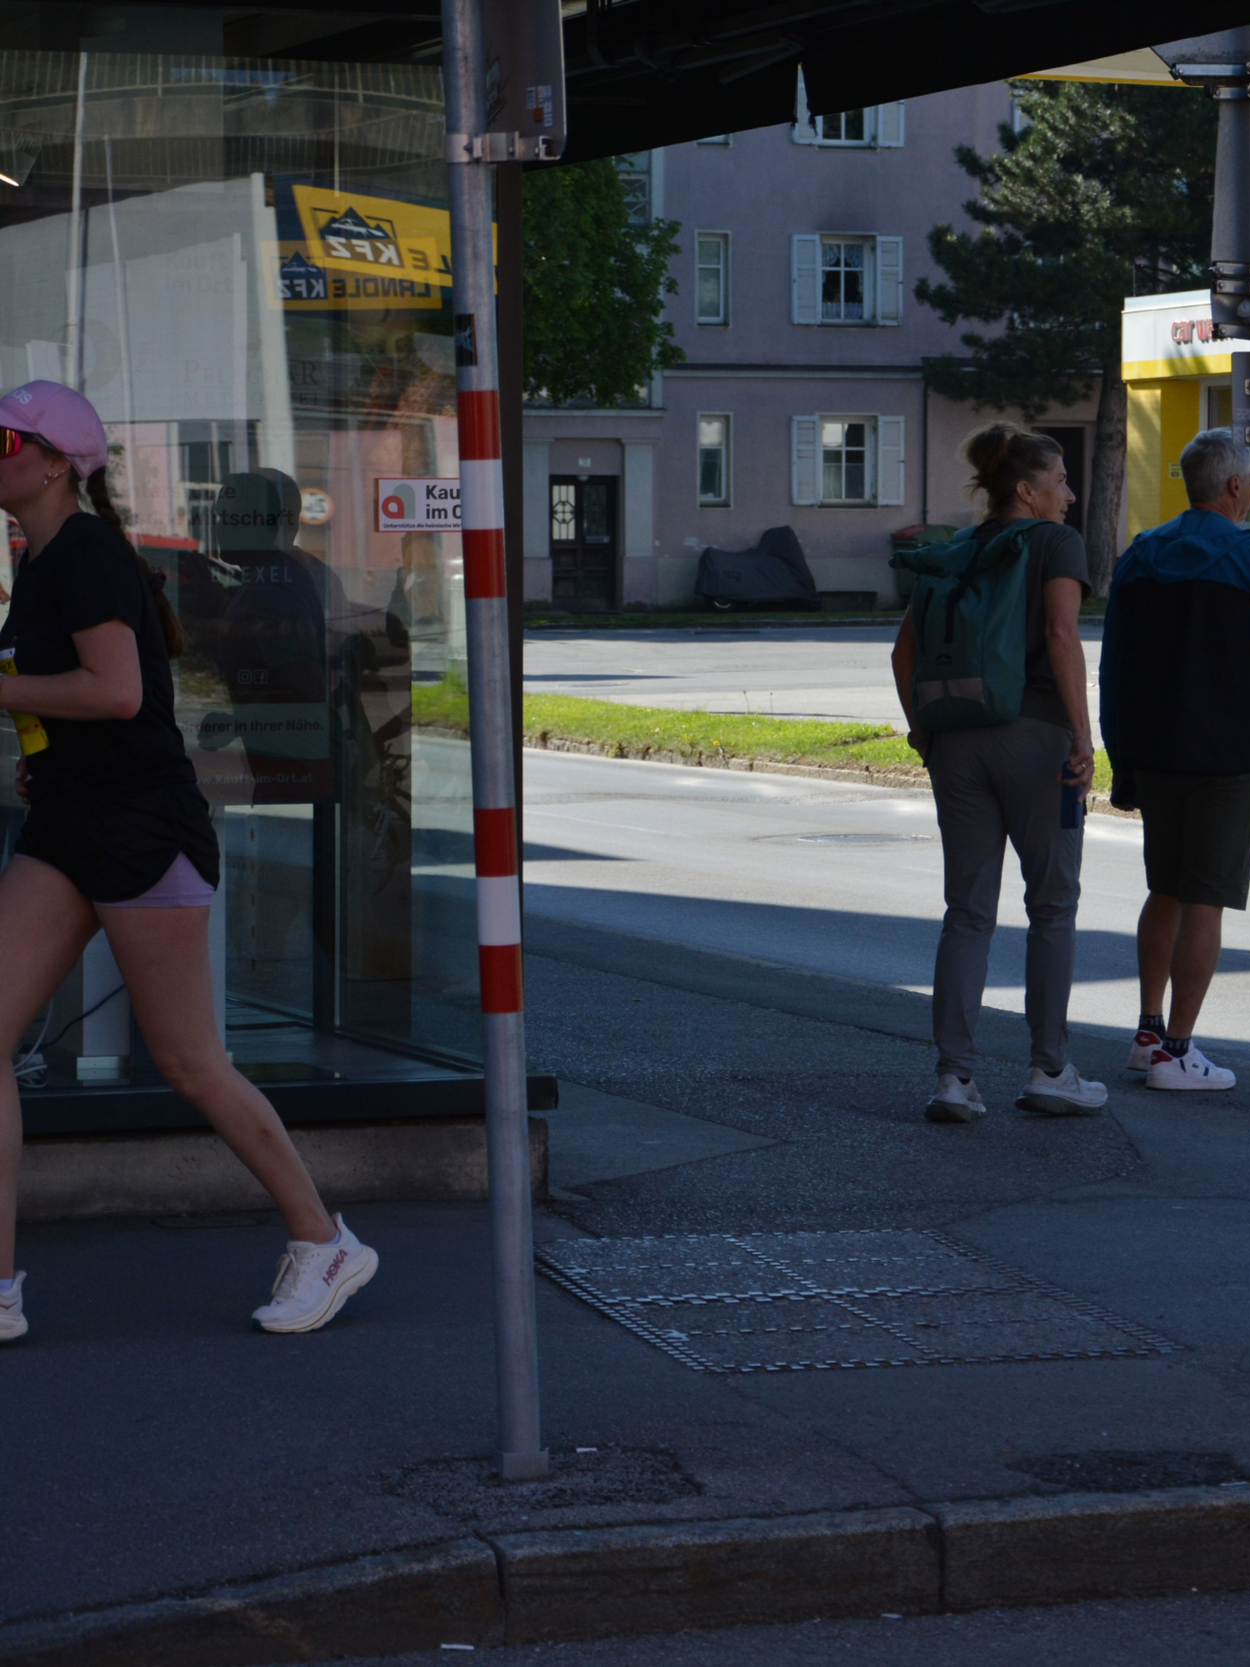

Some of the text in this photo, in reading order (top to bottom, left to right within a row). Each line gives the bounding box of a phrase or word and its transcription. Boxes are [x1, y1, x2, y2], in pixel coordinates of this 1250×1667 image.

[1171, 318, 1214, 345] car wa
[425, 485, 461, 500] Kau
[426, 504, 462, 519] im O
[234, 719, 247, 732] in
[251, 720, 283, 732] Ihrer
[286, 718, 324, 731] Nähe.
[196, 773, 313, 785] w.Kauft-im-Ort.at
[322, 1248, 348, 1287] HOKA
